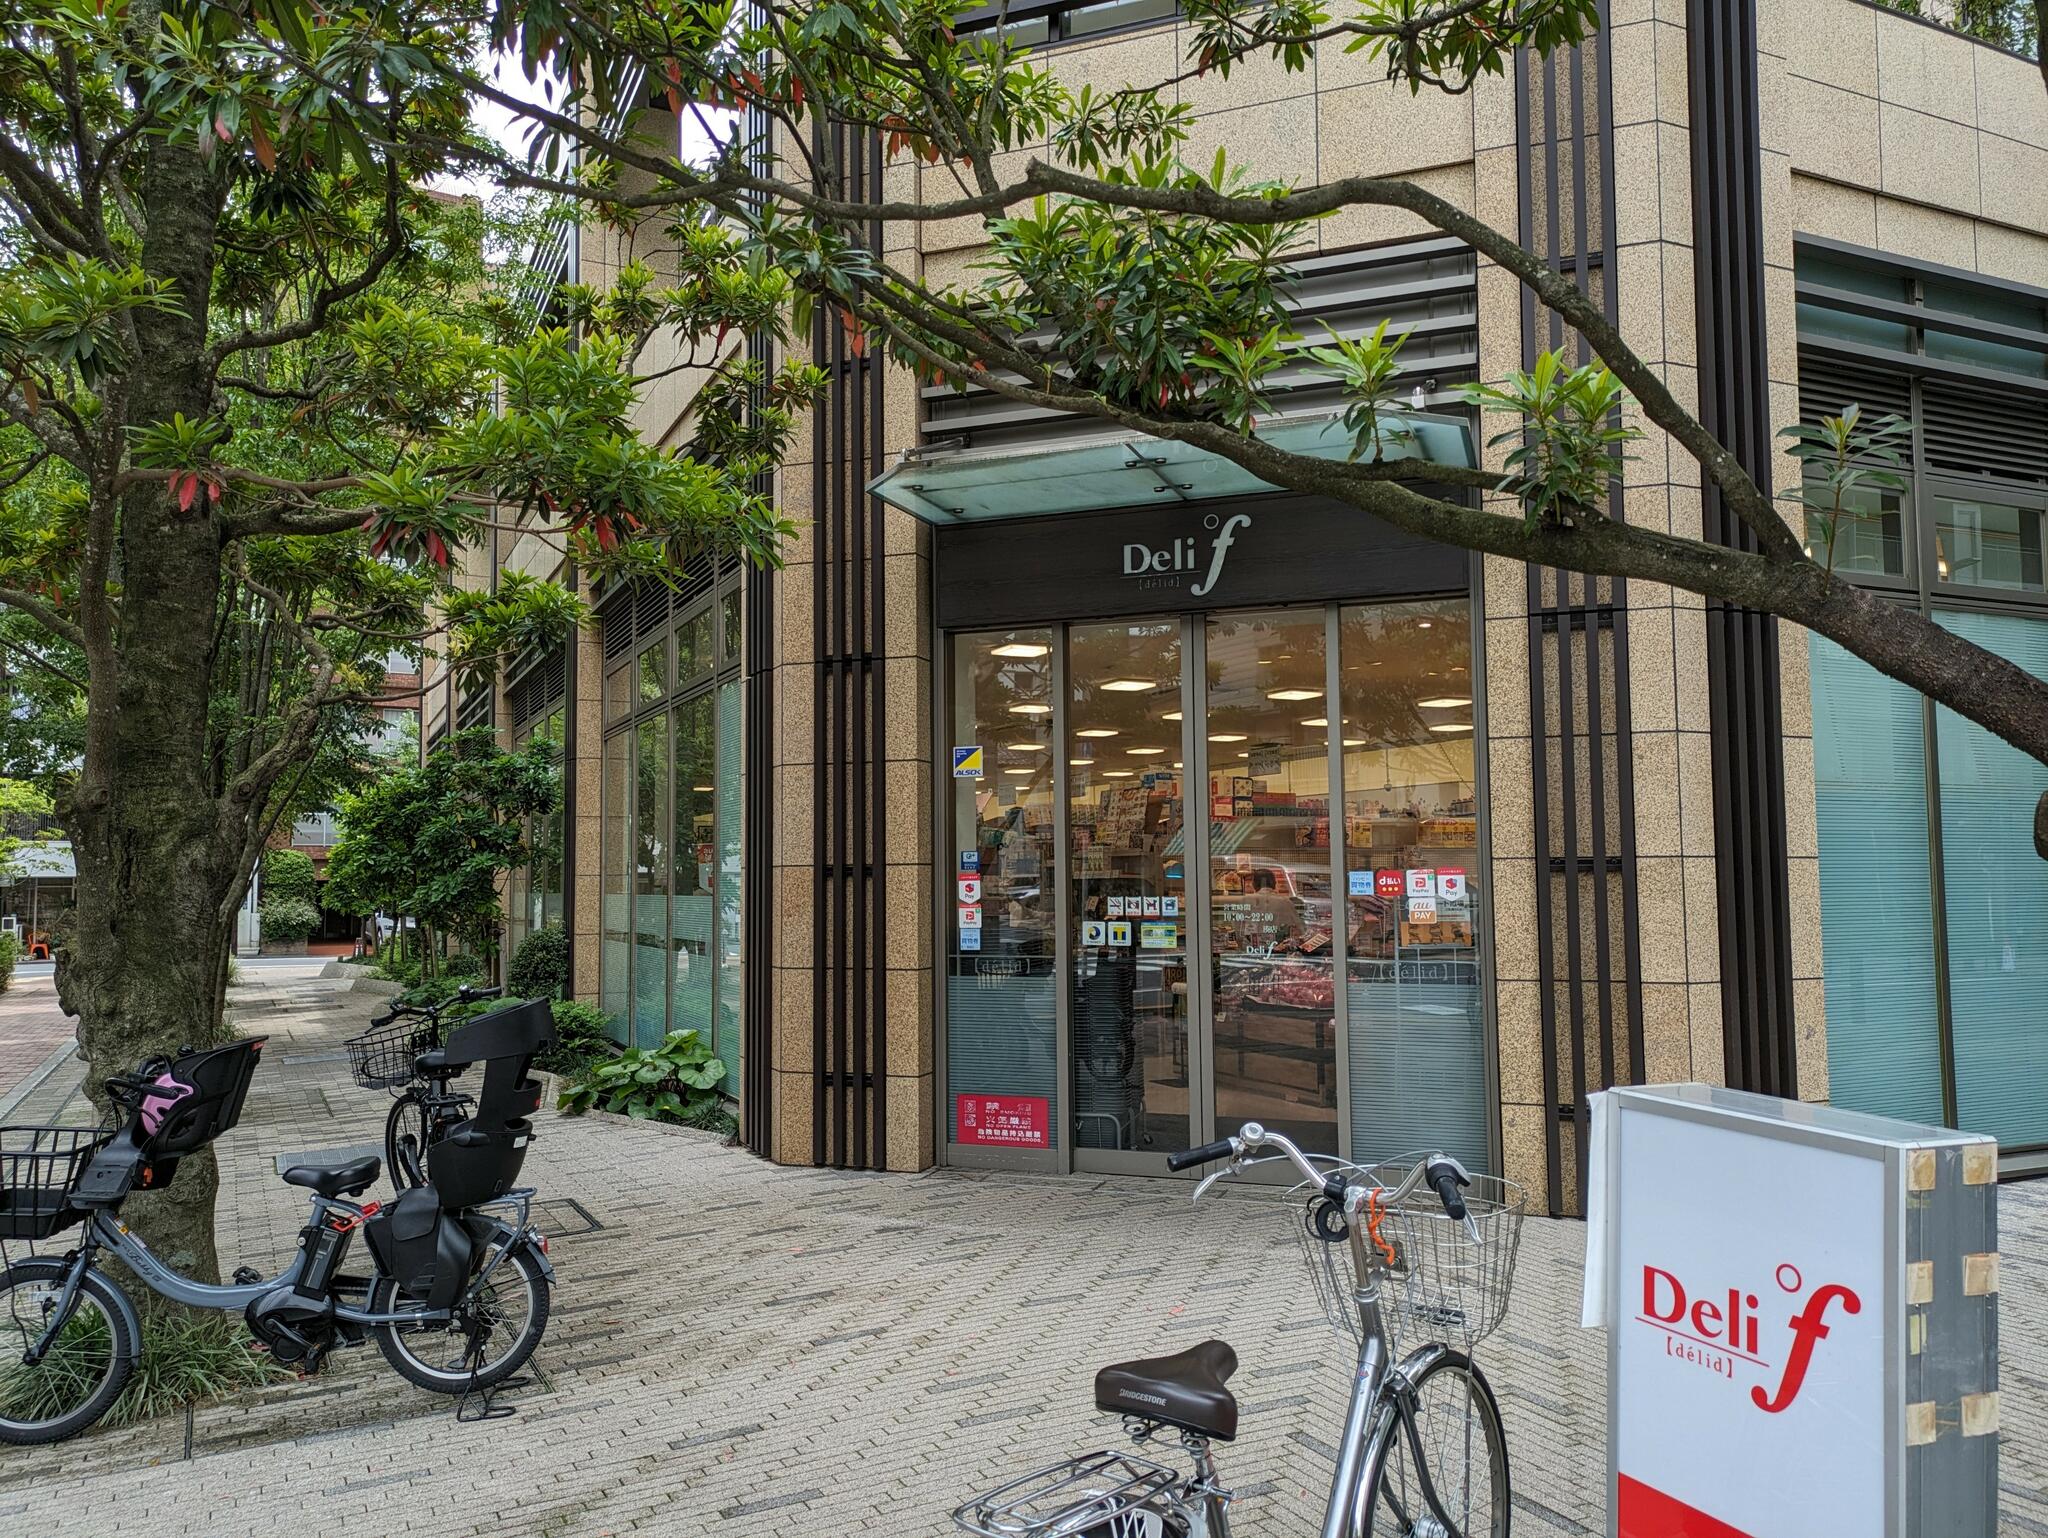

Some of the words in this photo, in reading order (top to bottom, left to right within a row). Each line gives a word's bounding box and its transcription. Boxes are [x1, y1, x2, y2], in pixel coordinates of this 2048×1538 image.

[1123, 537, 1195, 574] Deli
[1379, 876, 1401, 885] d払い
[1445, 889, 1457, 897] Pay
[1413, 902, 1432, 910] au
[1414, 911, 1431, 920] PAY
[1246, 945, 1265, 954] Deli
[1643, 1264, 1760, 1356] Deli
[1119, 1388, 1168, 1407] BRIDGESTONE
